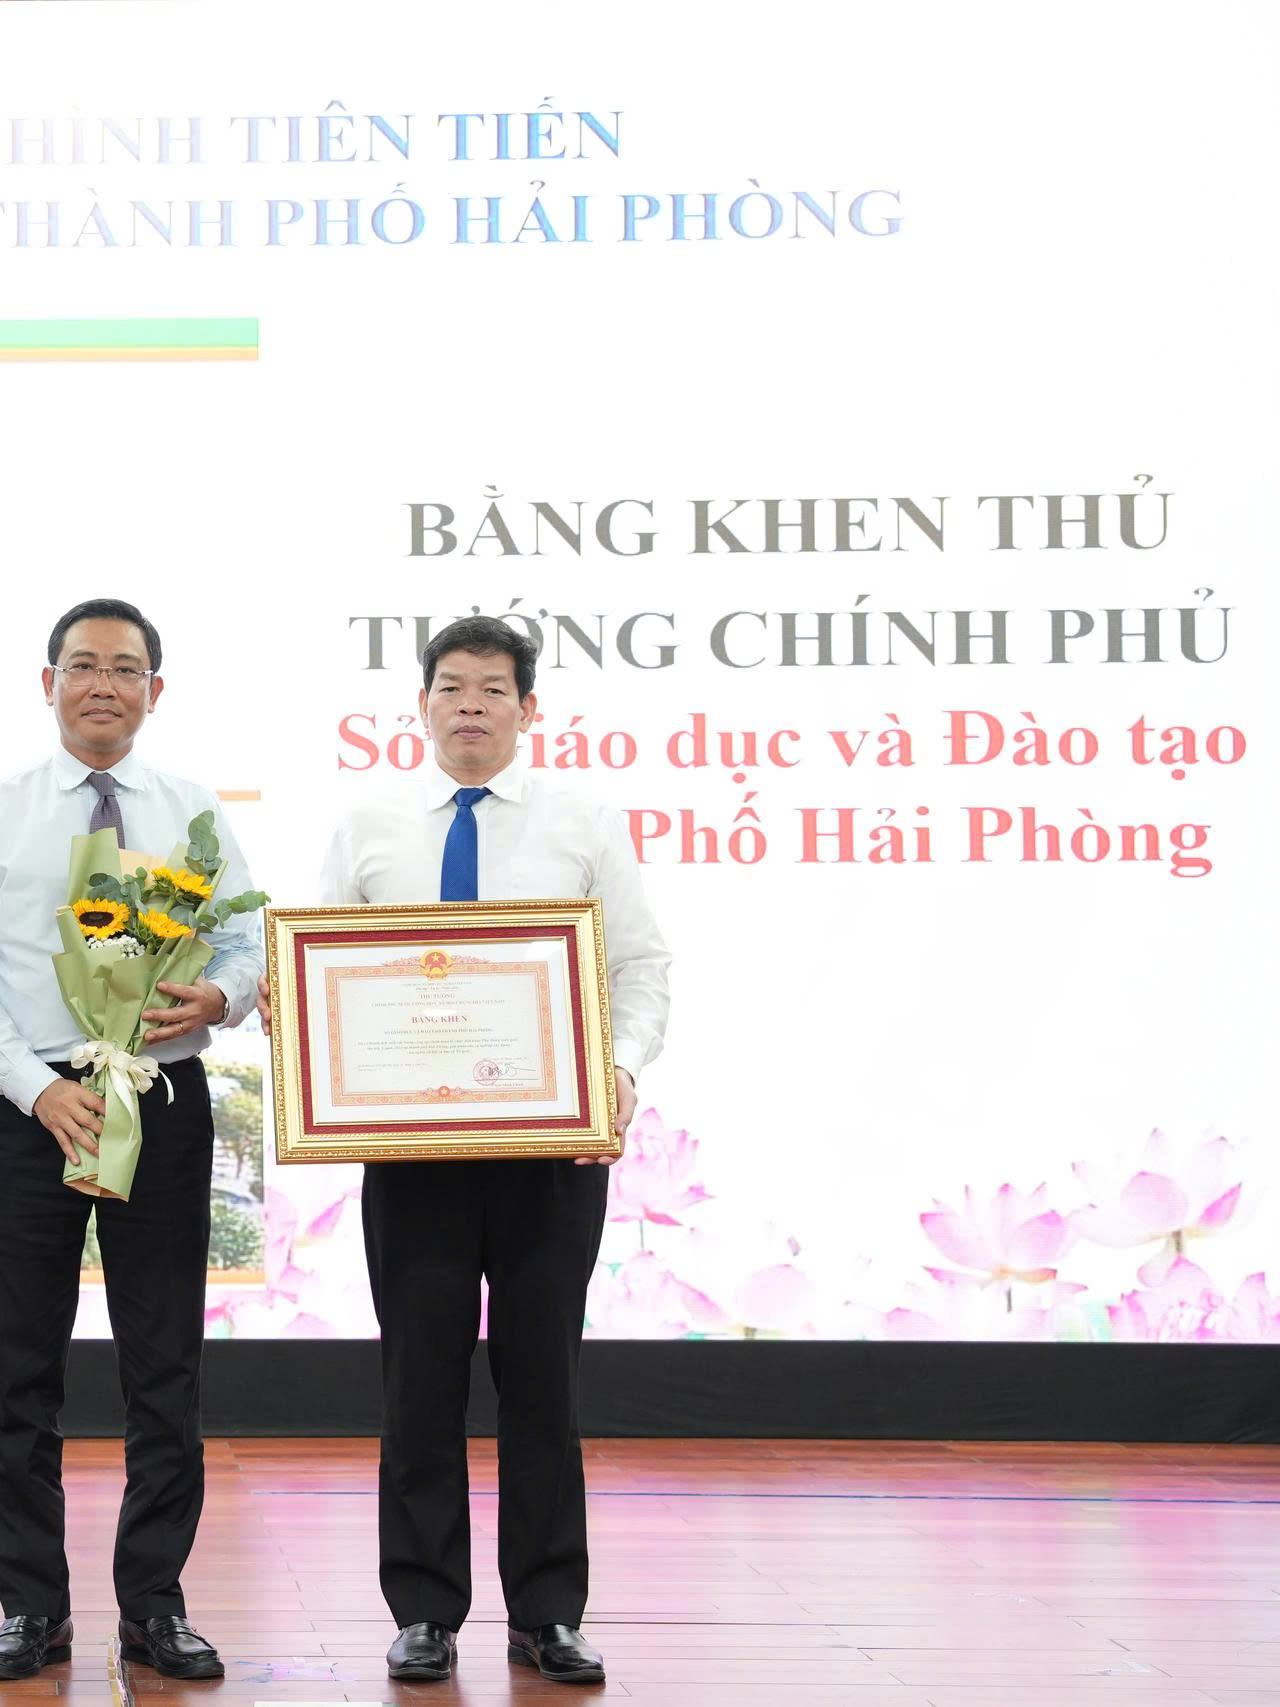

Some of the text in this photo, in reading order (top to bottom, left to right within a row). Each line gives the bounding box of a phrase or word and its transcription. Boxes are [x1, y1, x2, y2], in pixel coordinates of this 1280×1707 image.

[229, 100, 415, 164] TIÊN
[437, 96, 625, 162] TIẾN
[263, 182, 427, 247] PHỐ
[449, 180, 594, 247] HẢI
[616, 178, 905, 243] PHÒNG
[402, 472, 1176, 558] BẰNG KHEN THỦ
[709, 593, 1015, 669] CHÍNH
[1042, 586, 1237, 665] PHỦ
[337, 710, 1247, 784] Sở iáo dục và Đào tạo
[622, 790, 1214, 879] Phố Hải Phòng
